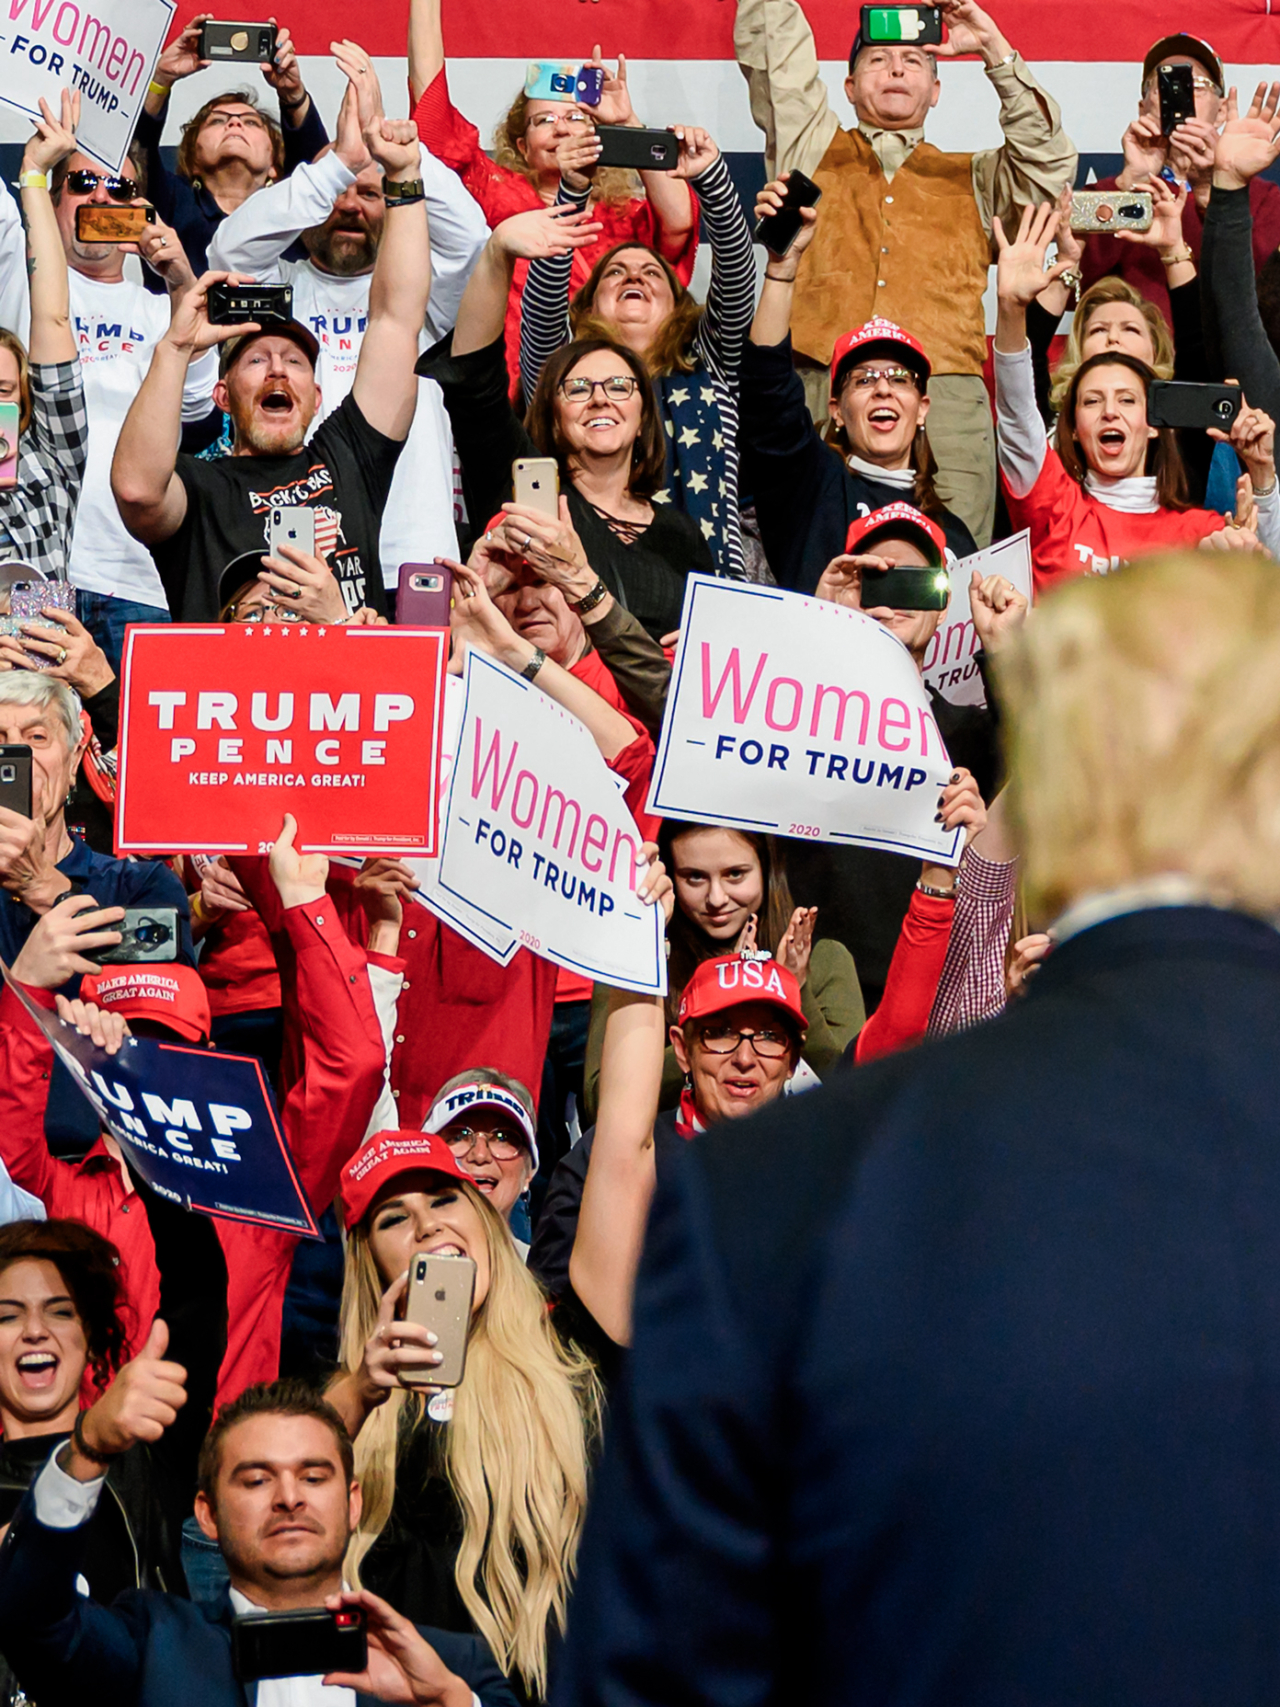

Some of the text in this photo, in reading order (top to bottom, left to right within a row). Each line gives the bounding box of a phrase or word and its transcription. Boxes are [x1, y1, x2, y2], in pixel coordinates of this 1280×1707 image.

[10, 35, 119, 113] FOR TRUMP
[309, 315, 367, 334] TRU
[1074, 543, 1130, 576] TRU
[938, 662, 981, 691] TRU
[149, 691, 415, 732] TRUMP
[701, 641, 949, 762] Women
[170, 738, 386, 765] PENCE
[715, 734, 927, 791] FOR TRUMP
[189, 772, 365, 787] KEEP AMERICA GREAT!
[471, 716, 637, 892] Women
[788, 822, 820, 837] 2020
[258, 842, 275, 854] 20
[475, 818, 523, 870] FOR
[533, 852, 615, 917] TRUMP
[519, 930, 541, 950] 2020
[97, 974, 180, 994] MAKE AMERICA
[102, 987, 174, 1004] GREAT AGAIN
[715, 960, 787, 1000] USA
[80, 1058, 251, 1136] UMP
[445, 1089, 525, 1118] TRUMP
[115, 1110, 241, 1161] NCE
[172, 1152, 228, 1175] GREAT!
[349, 1139, 431, 1177] MAKE AMERICA
[356, 1146, 431, 1181] GREAT AGAIN
